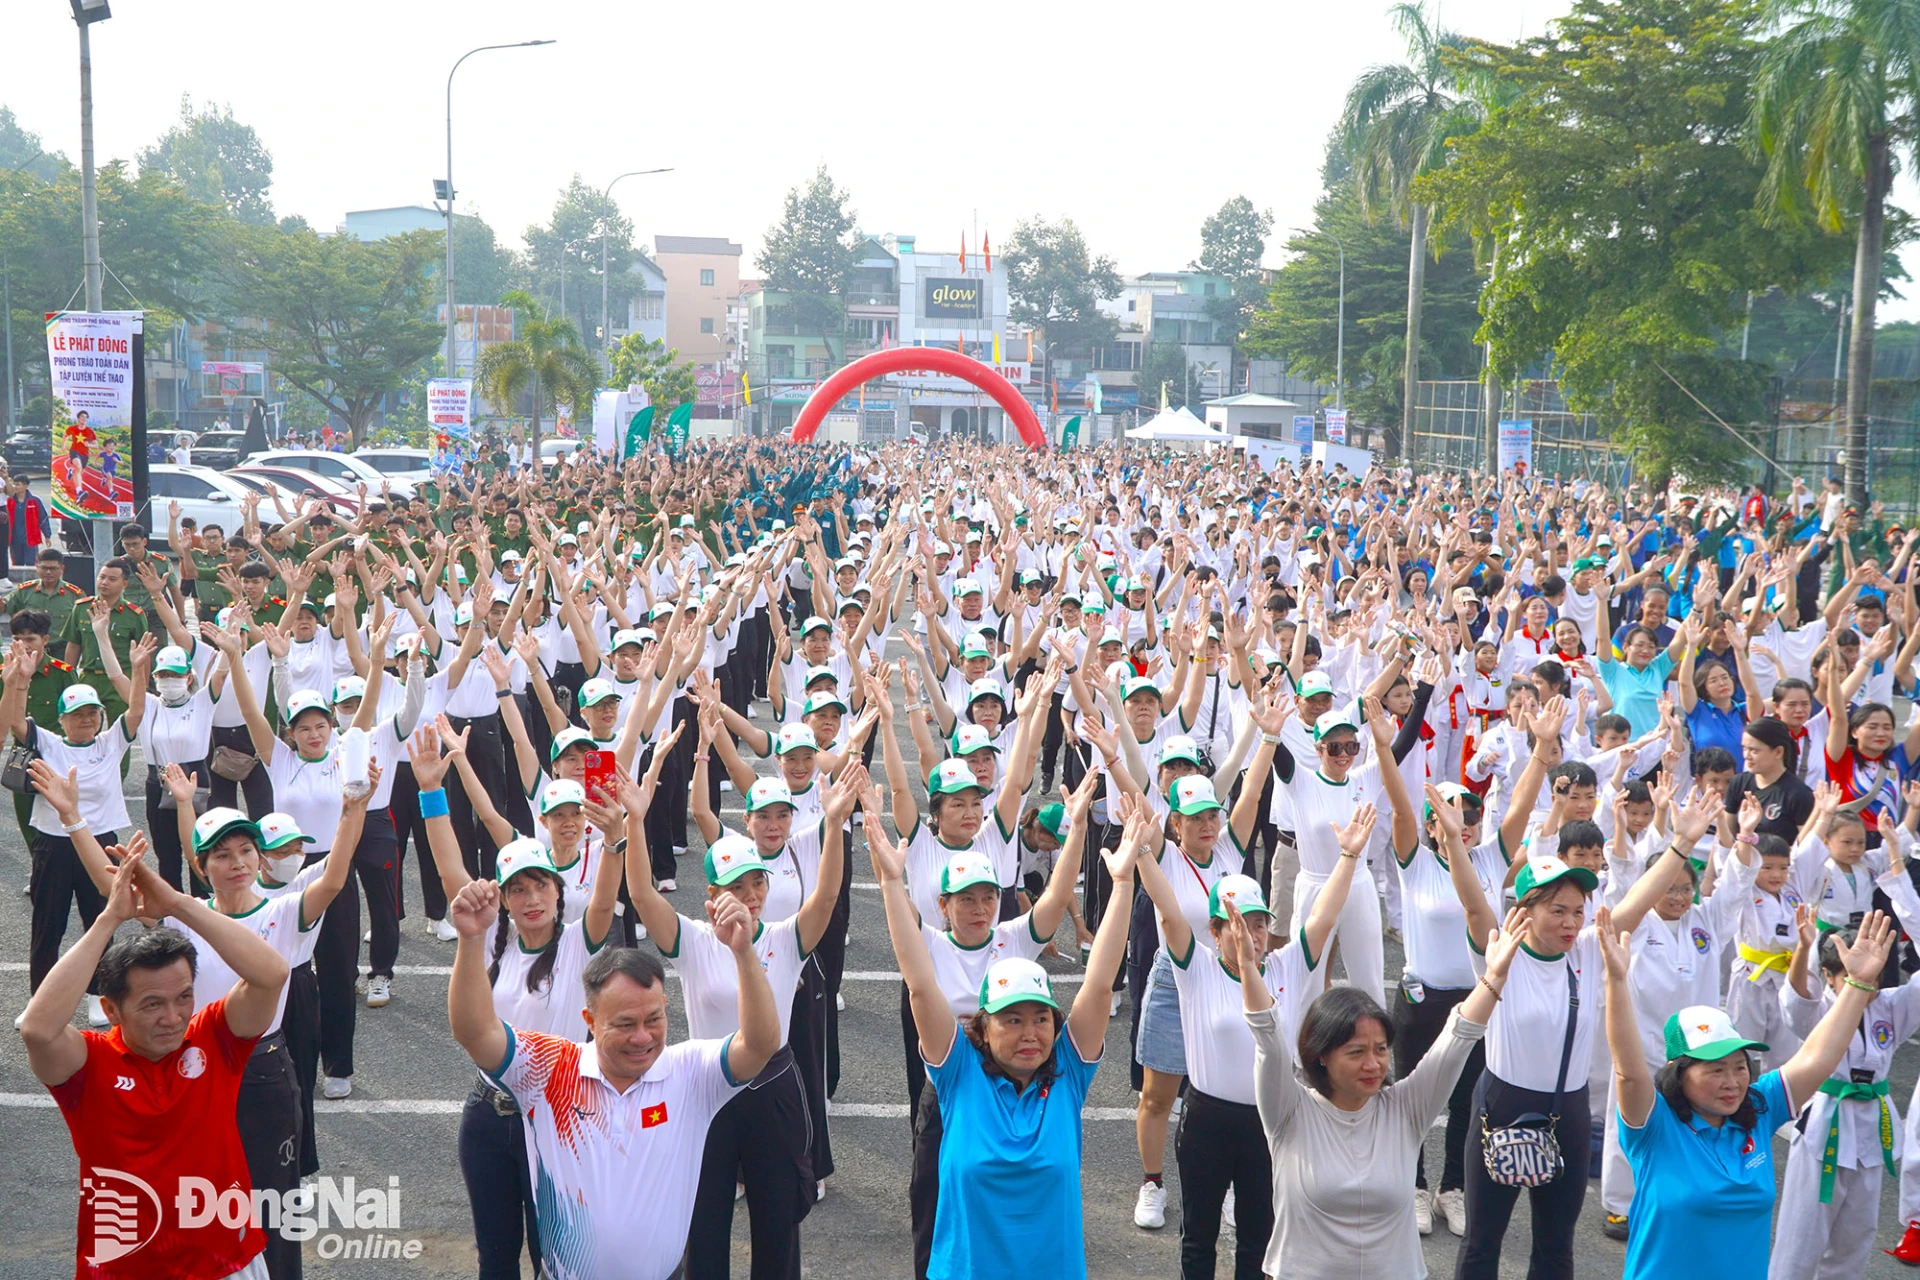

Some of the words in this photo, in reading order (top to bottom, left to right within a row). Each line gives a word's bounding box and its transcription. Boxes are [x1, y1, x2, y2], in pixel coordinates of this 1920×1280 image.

[933, 284, 976, 304] glow
[53, 332, 66, 351] LỄ
[68, 334, 95, 352] PHÁT
[97, 335, 128, 356] ĐỘNG
[54, 356, 76, 367] PHONG
[113, 358, 129, 370] DÂN
[59, 370, 71, 383] TẬP
[72, 371, 92, 384] LUYỆN
[107, 373, 124, 384] THAO
[994, 366, 1022, 379] AIN
